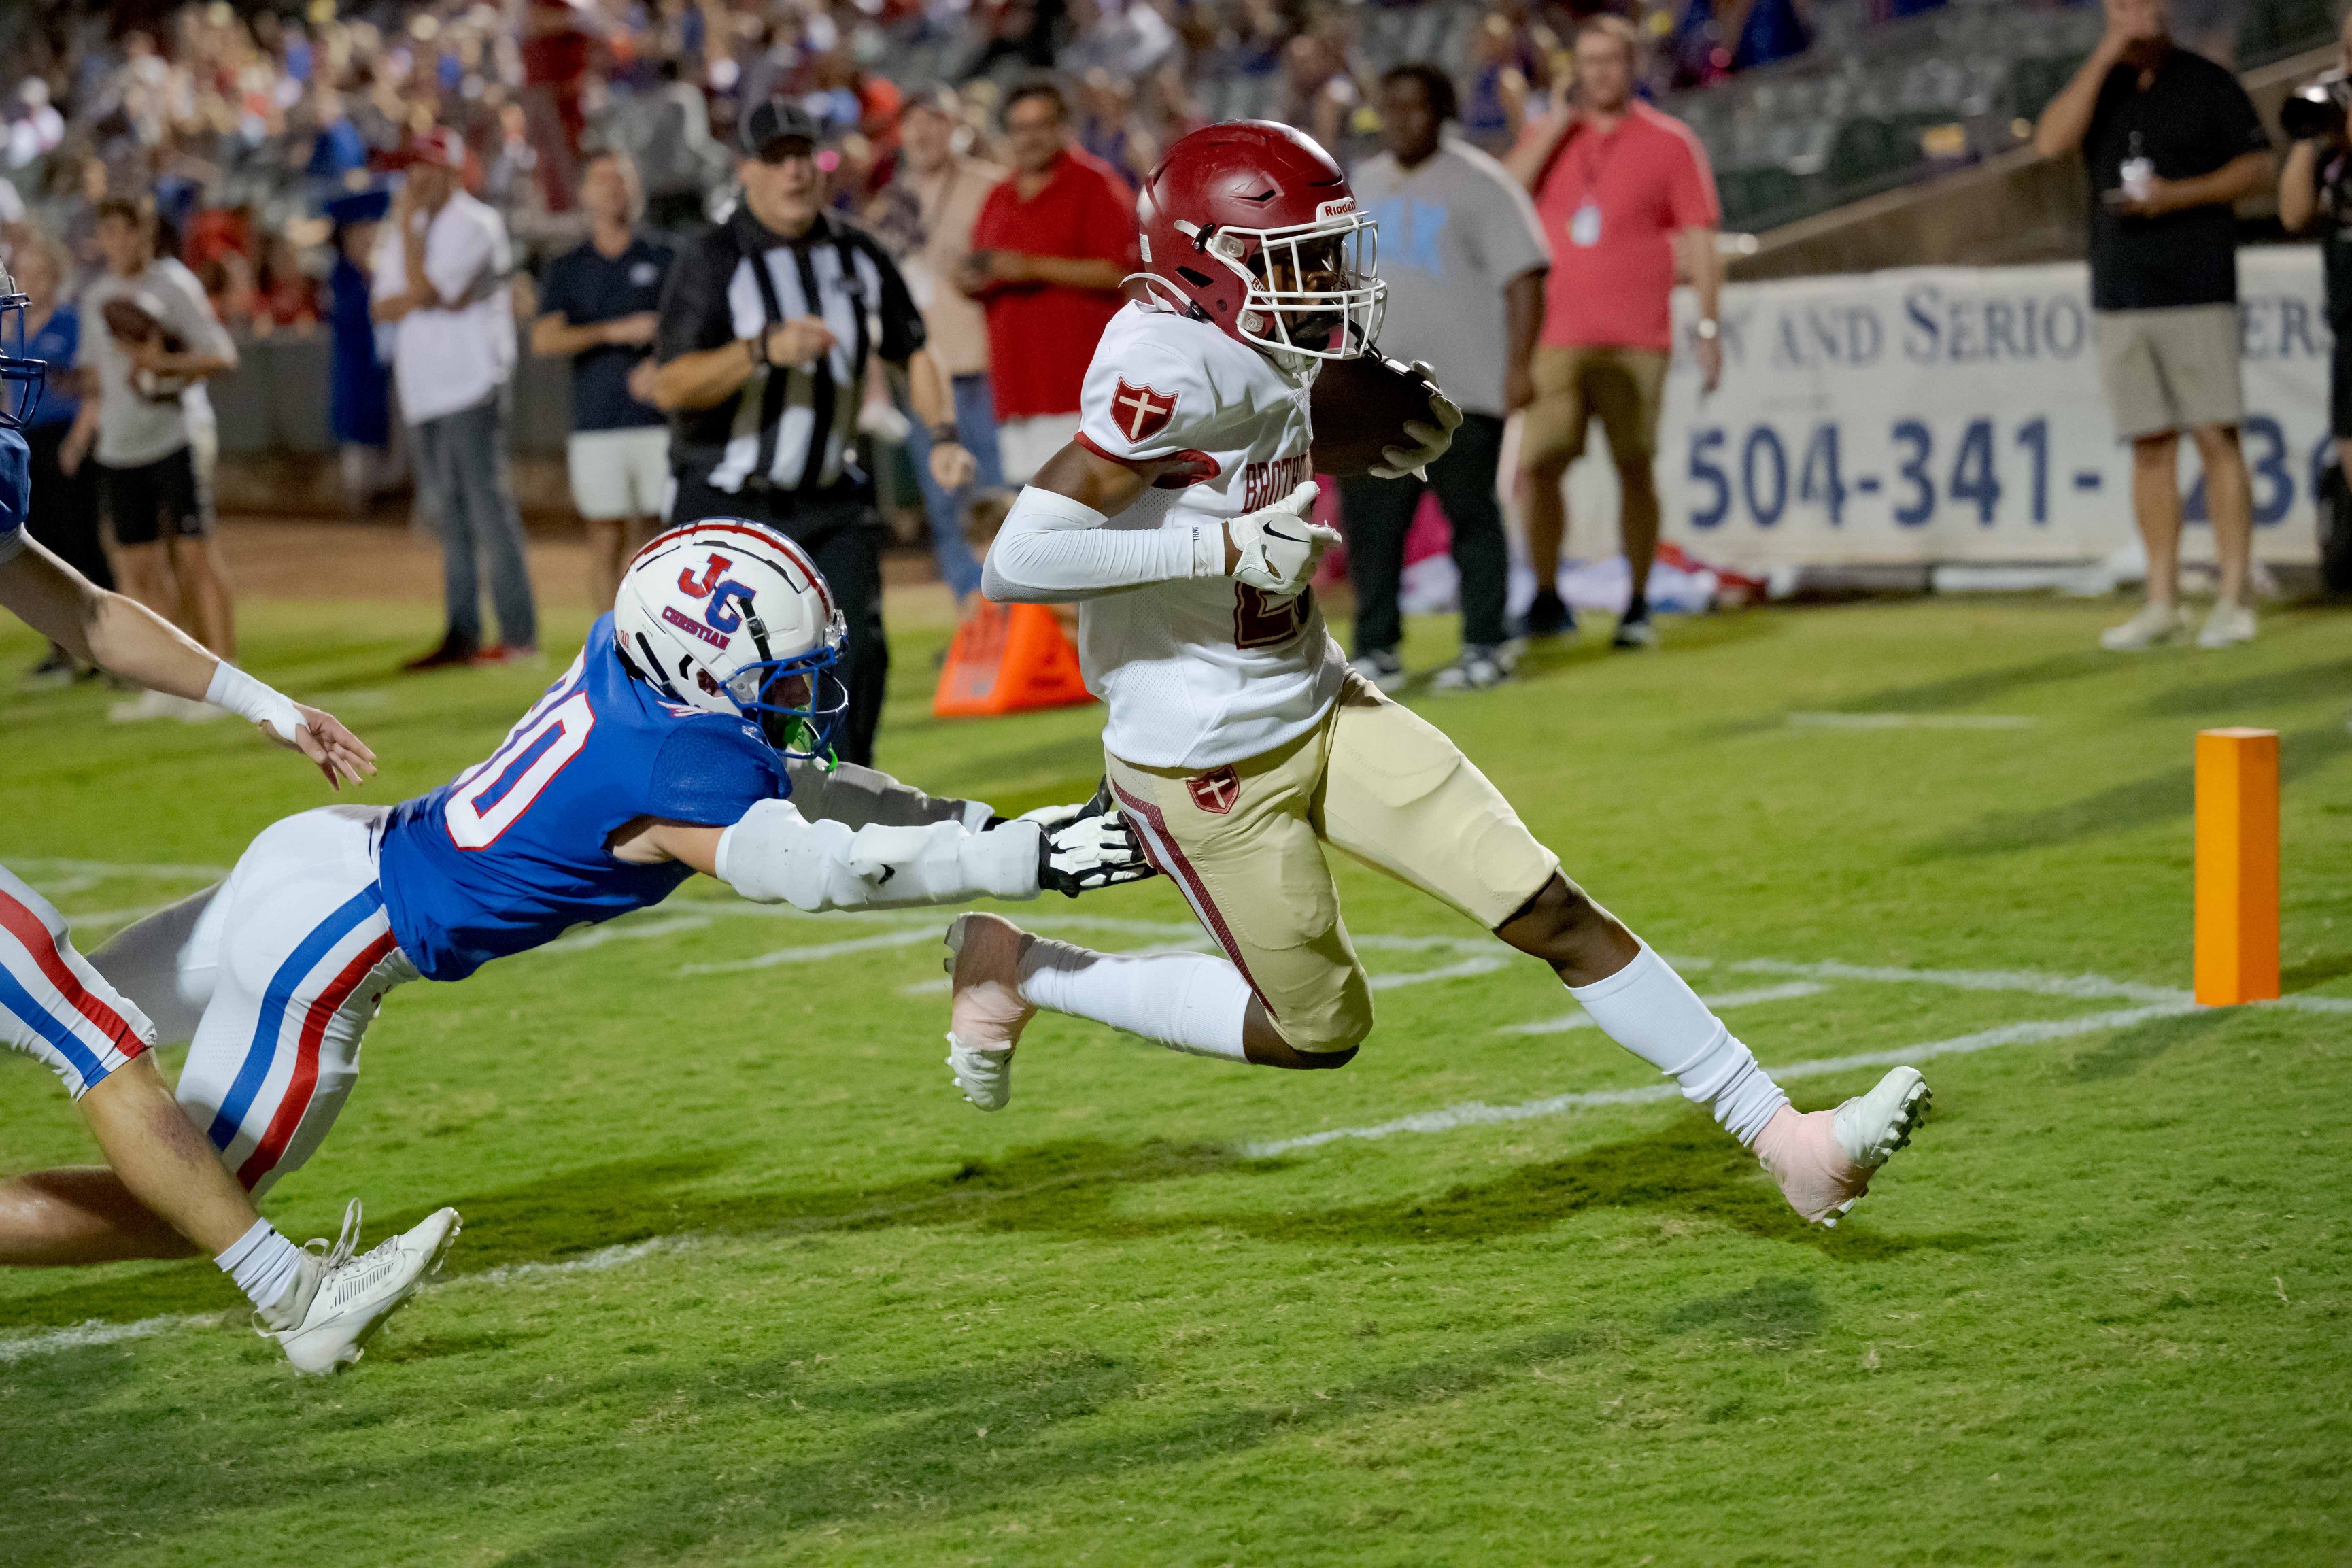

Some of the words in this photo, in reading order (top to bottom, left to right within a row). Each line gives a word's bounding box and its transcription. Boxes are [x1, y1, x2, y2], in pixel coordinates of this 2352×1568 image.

[1324, 200, 1357, 216] Riddell
[1771, 303, 1883, 367] AND
[1903, 283, 2086, 363] SERIO
[1689, 415, 2331, 529] 504-341-3
[662, 605, 731, 651] CHRISTIAN
[677, 553, 757, 634] JC
